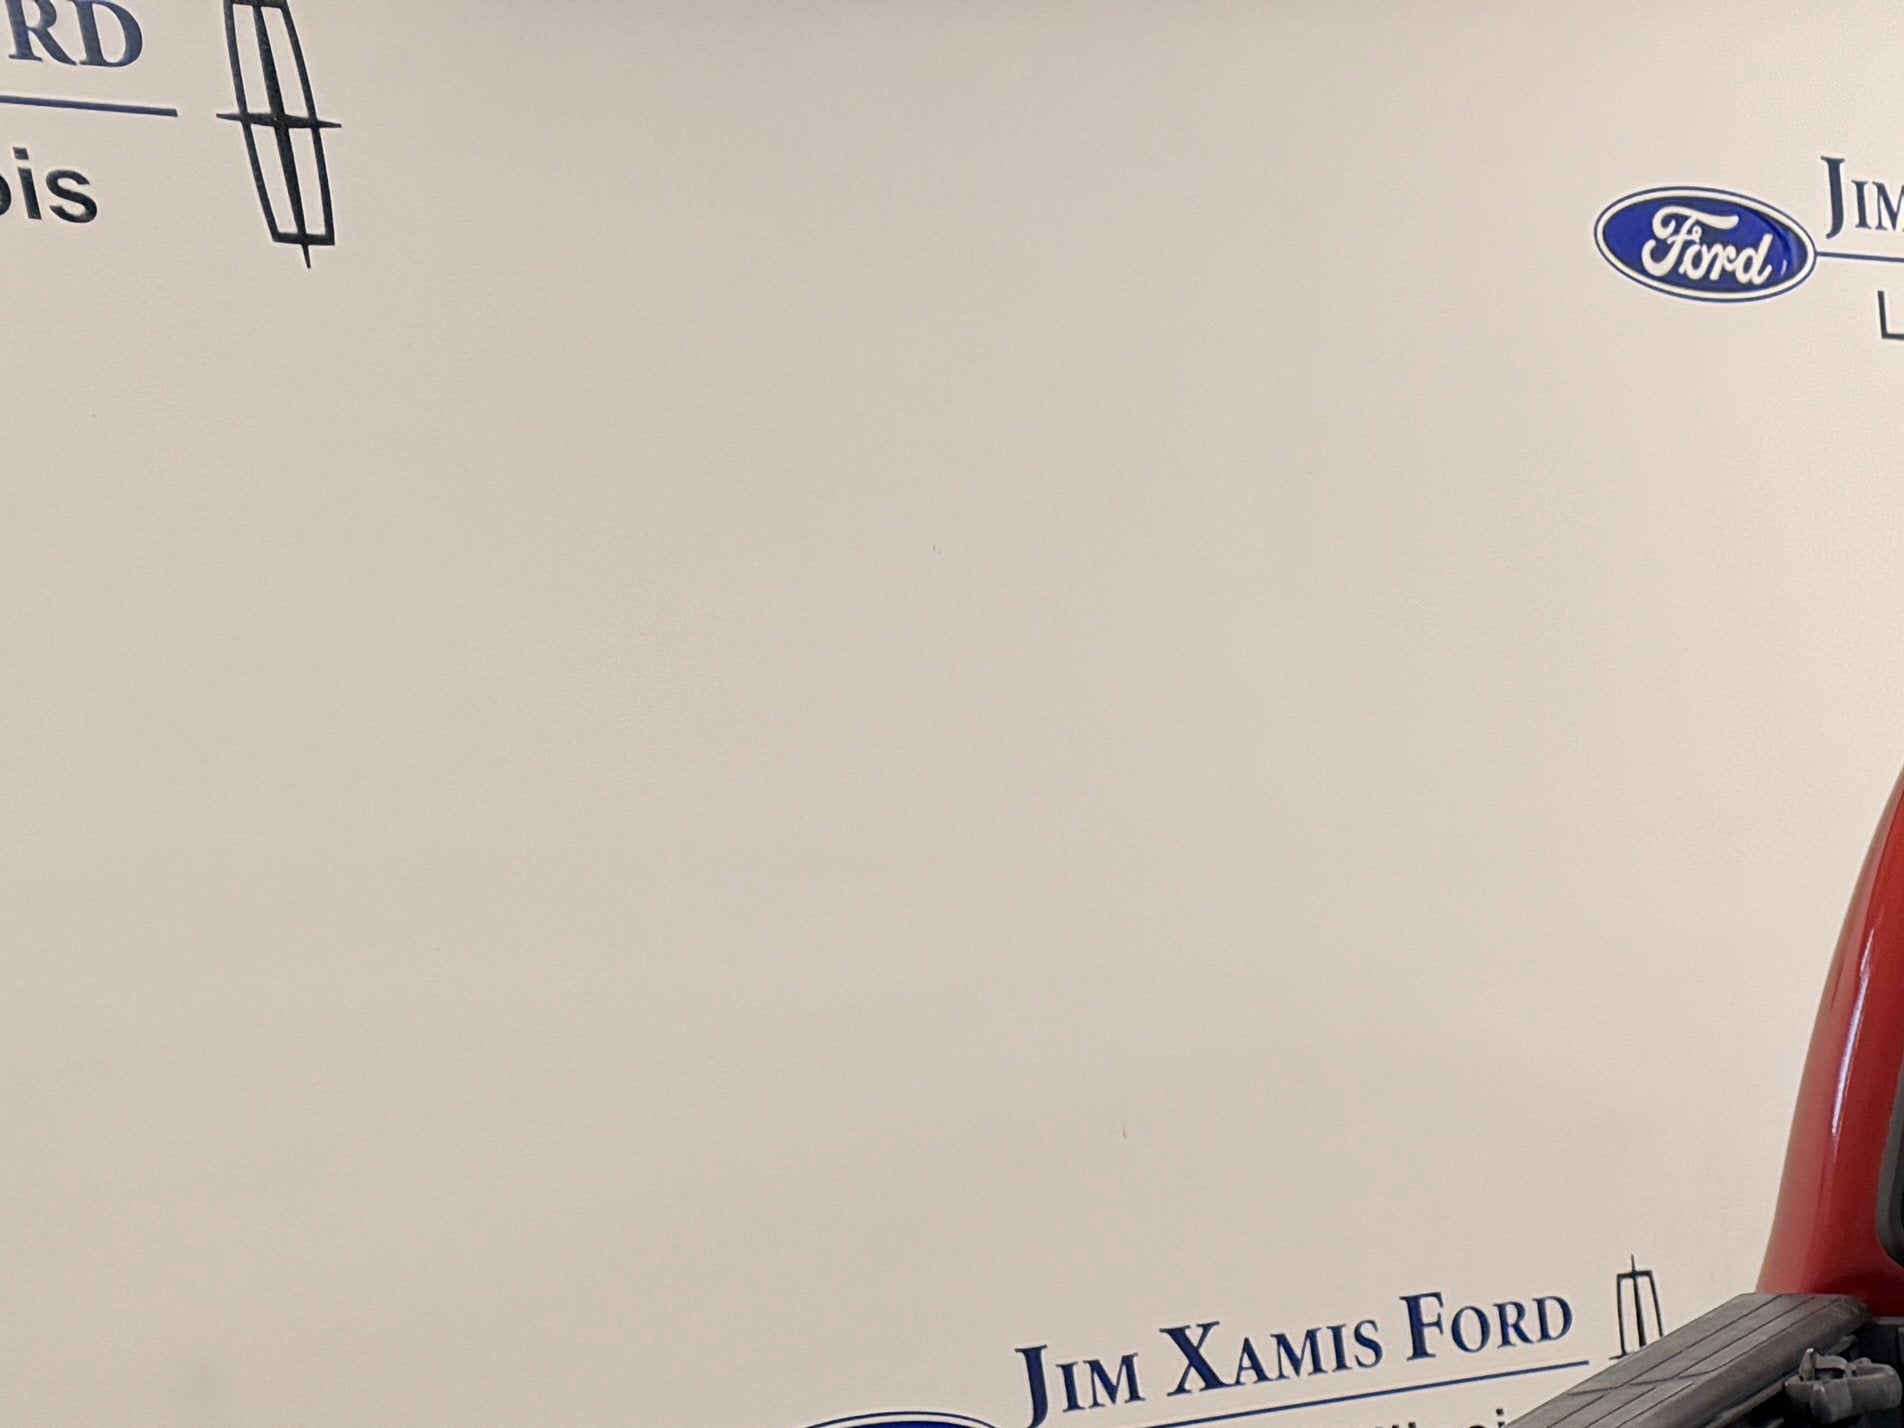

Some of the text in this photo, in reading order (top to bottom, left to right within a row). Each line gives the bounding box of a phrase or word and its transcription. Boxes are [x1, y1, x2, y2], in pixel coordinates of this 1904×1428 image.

[4, 0, 143, 68] RD
[1641, 205, 1774, 286] Ford
[1158, 1320, 1384, 1397] XAMIS
[1398, 1291, 1573, 1362] FORD
